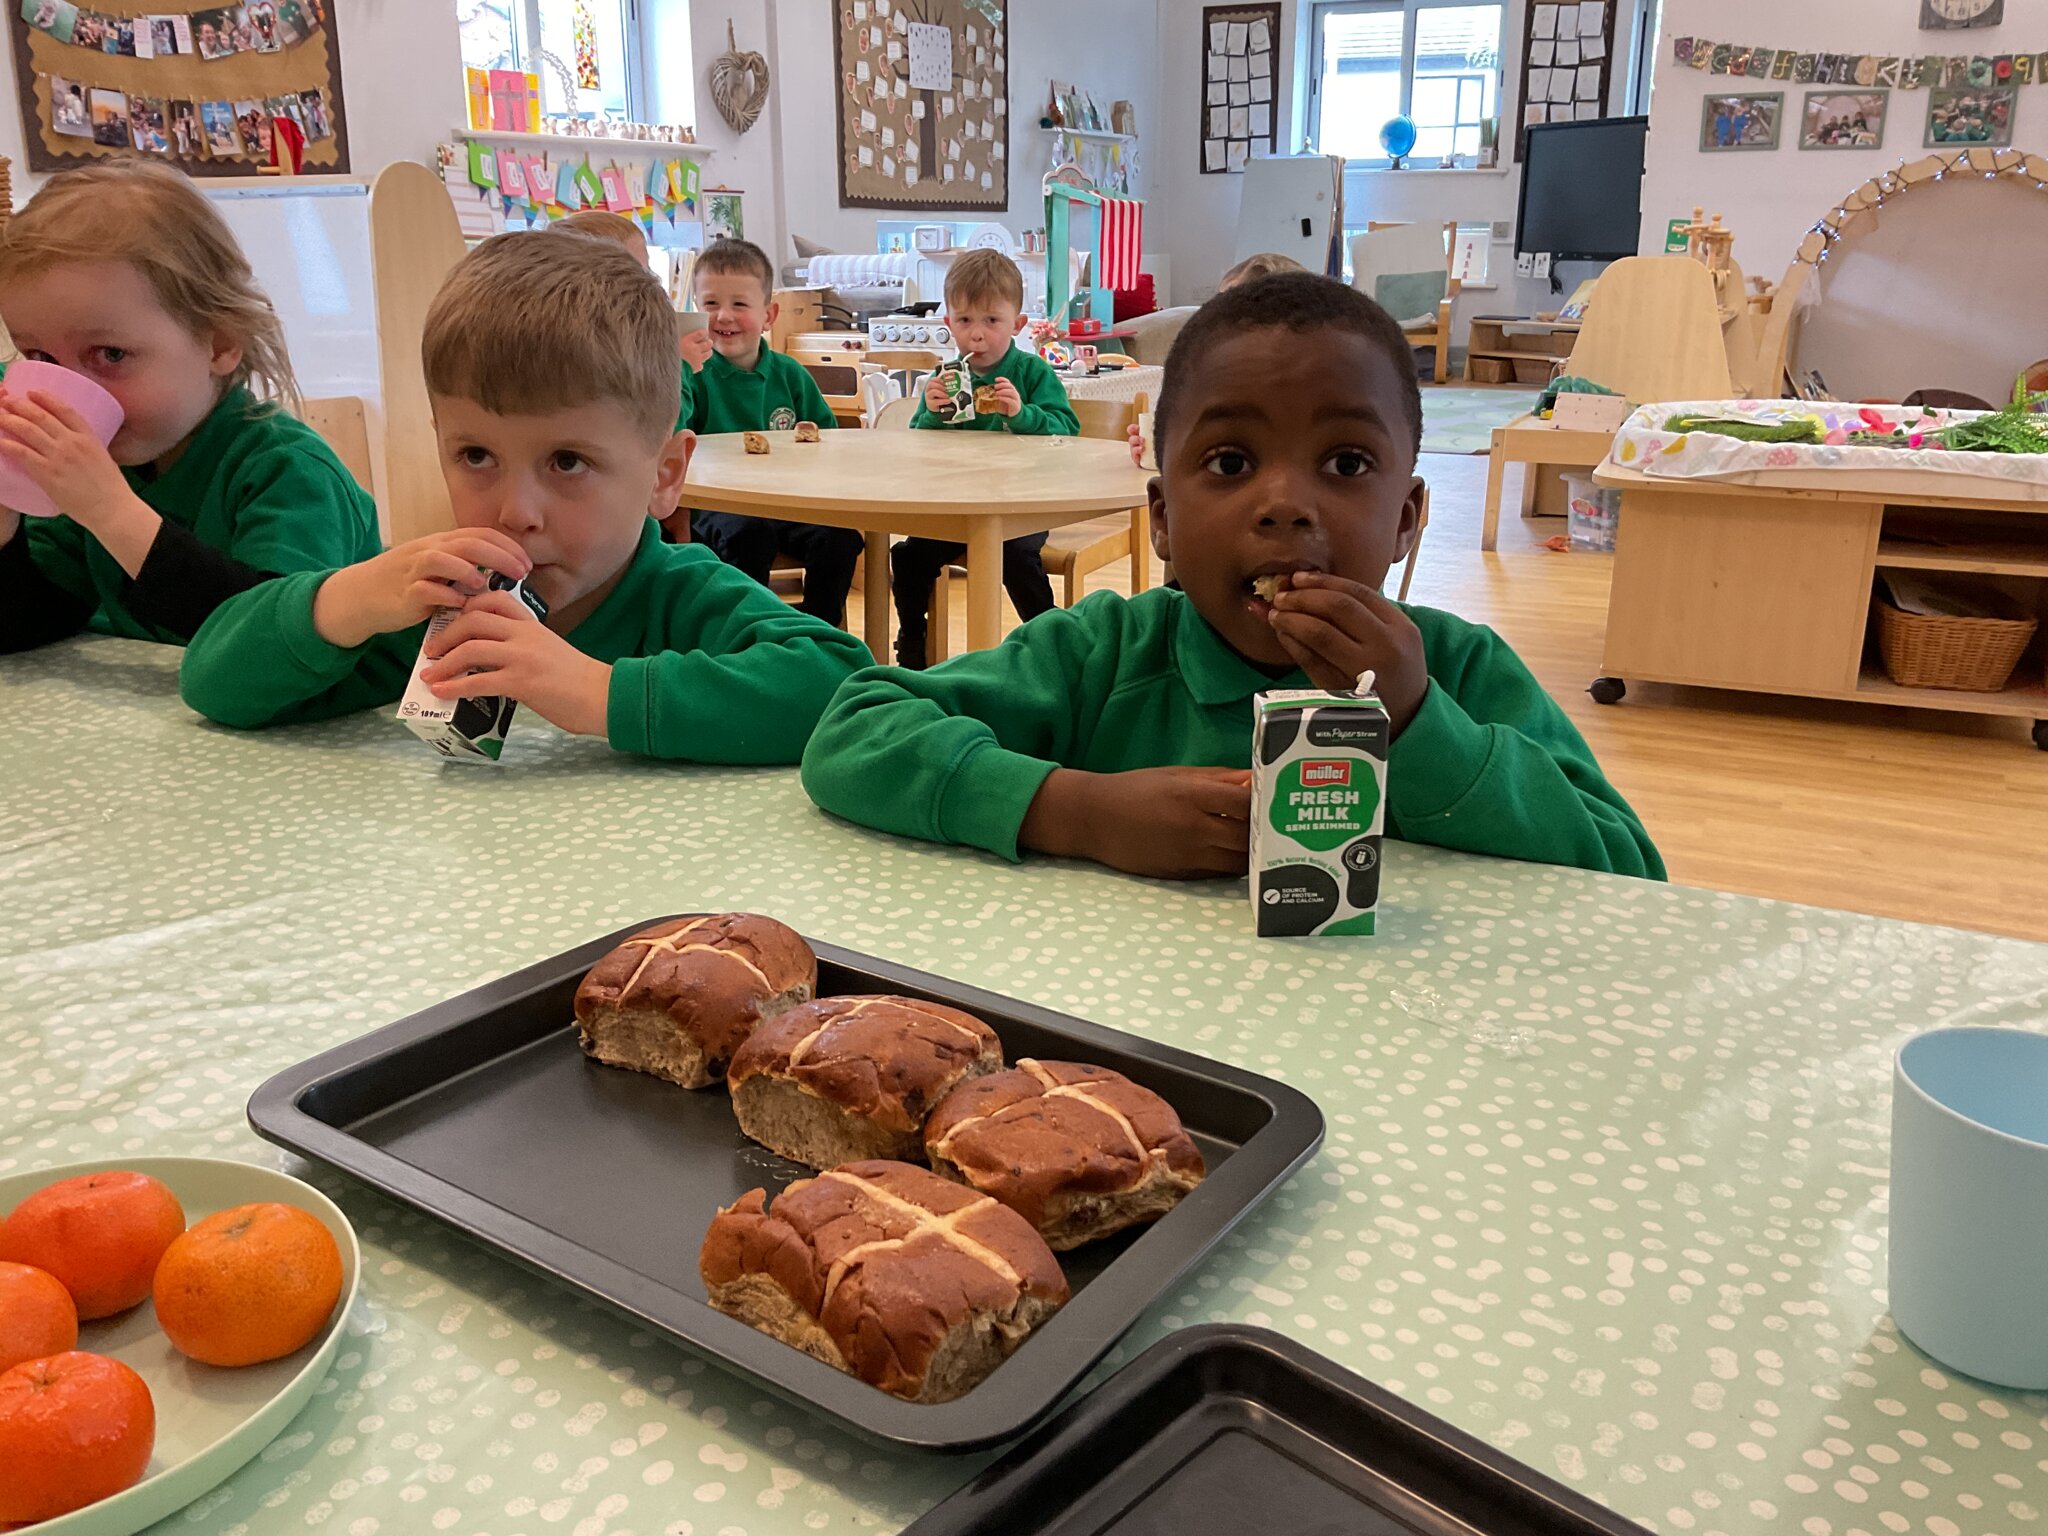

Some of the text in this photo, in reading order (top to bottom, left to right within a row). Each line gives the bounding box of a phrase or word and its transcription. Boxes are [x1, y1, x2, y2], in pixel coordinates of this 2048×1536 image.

[1332, 727, 1356, 740] Paper
[1305, 765, 1345, 780] müller
[1289, 791, 1359, 806] FRESH
[1297, 806, 1349, 821] MILK
[1285, 822, 1360, 832] SEMI SKIMMED
